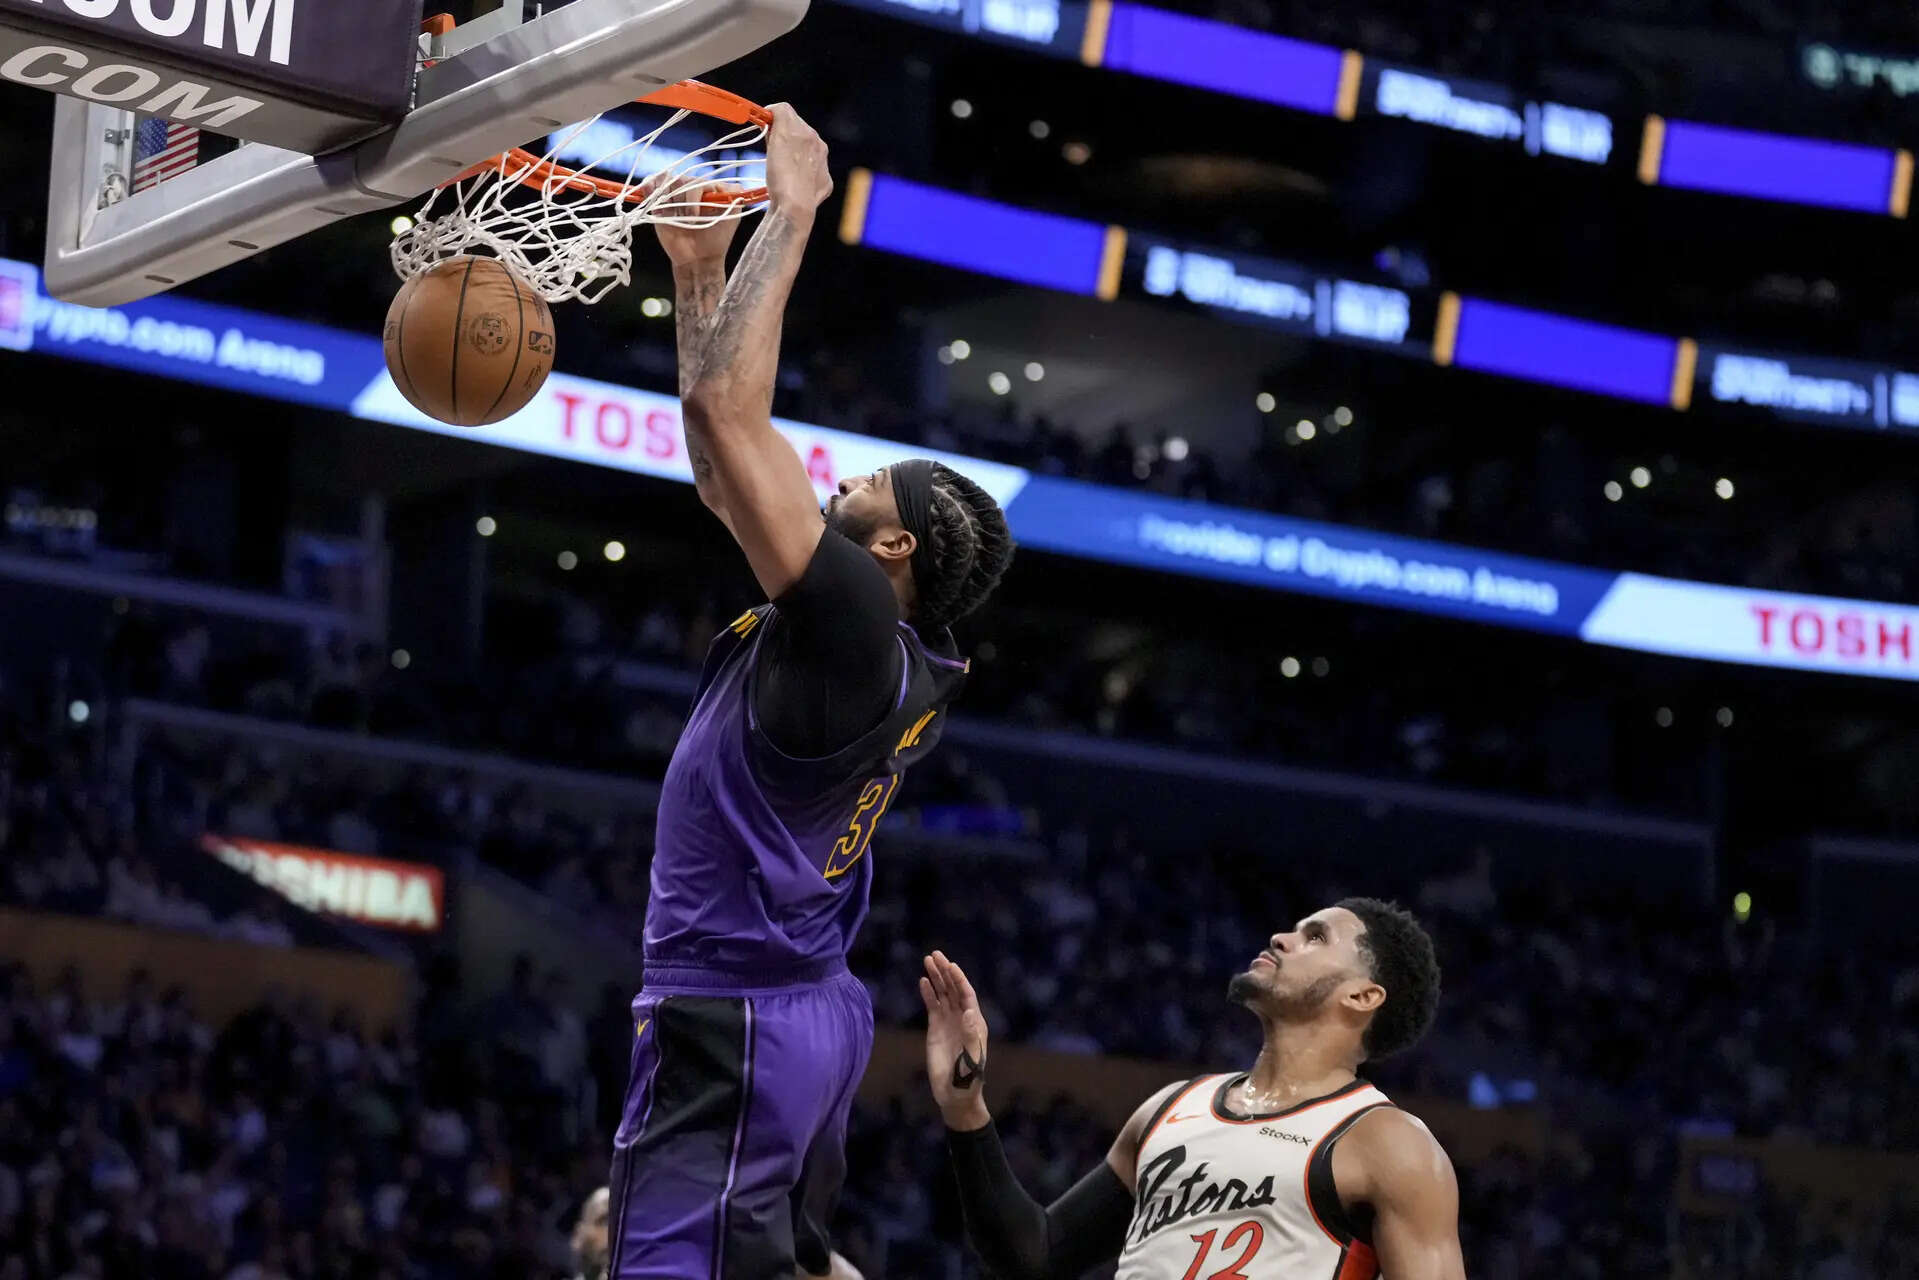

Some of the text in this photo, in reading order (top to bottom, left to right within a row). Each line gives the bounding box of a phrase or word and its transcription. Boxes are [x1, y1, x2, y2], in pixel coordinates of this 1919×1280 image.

[0, 45, 265, 128] COM
[34, 294, 325, 385] rypto.com Arena
[553, 391, 832, 488] TOSA
[1264, 534, 1299, 574] of
[1300, 537, 1470, 601] Crypto.com
[1471, 566, 1559, 616] Arena
[217, 845, 437, 927] SHIBA
[1258, 1126, 1312, 1147] StockX
[1182, 1220, 1264, 1280] 12
